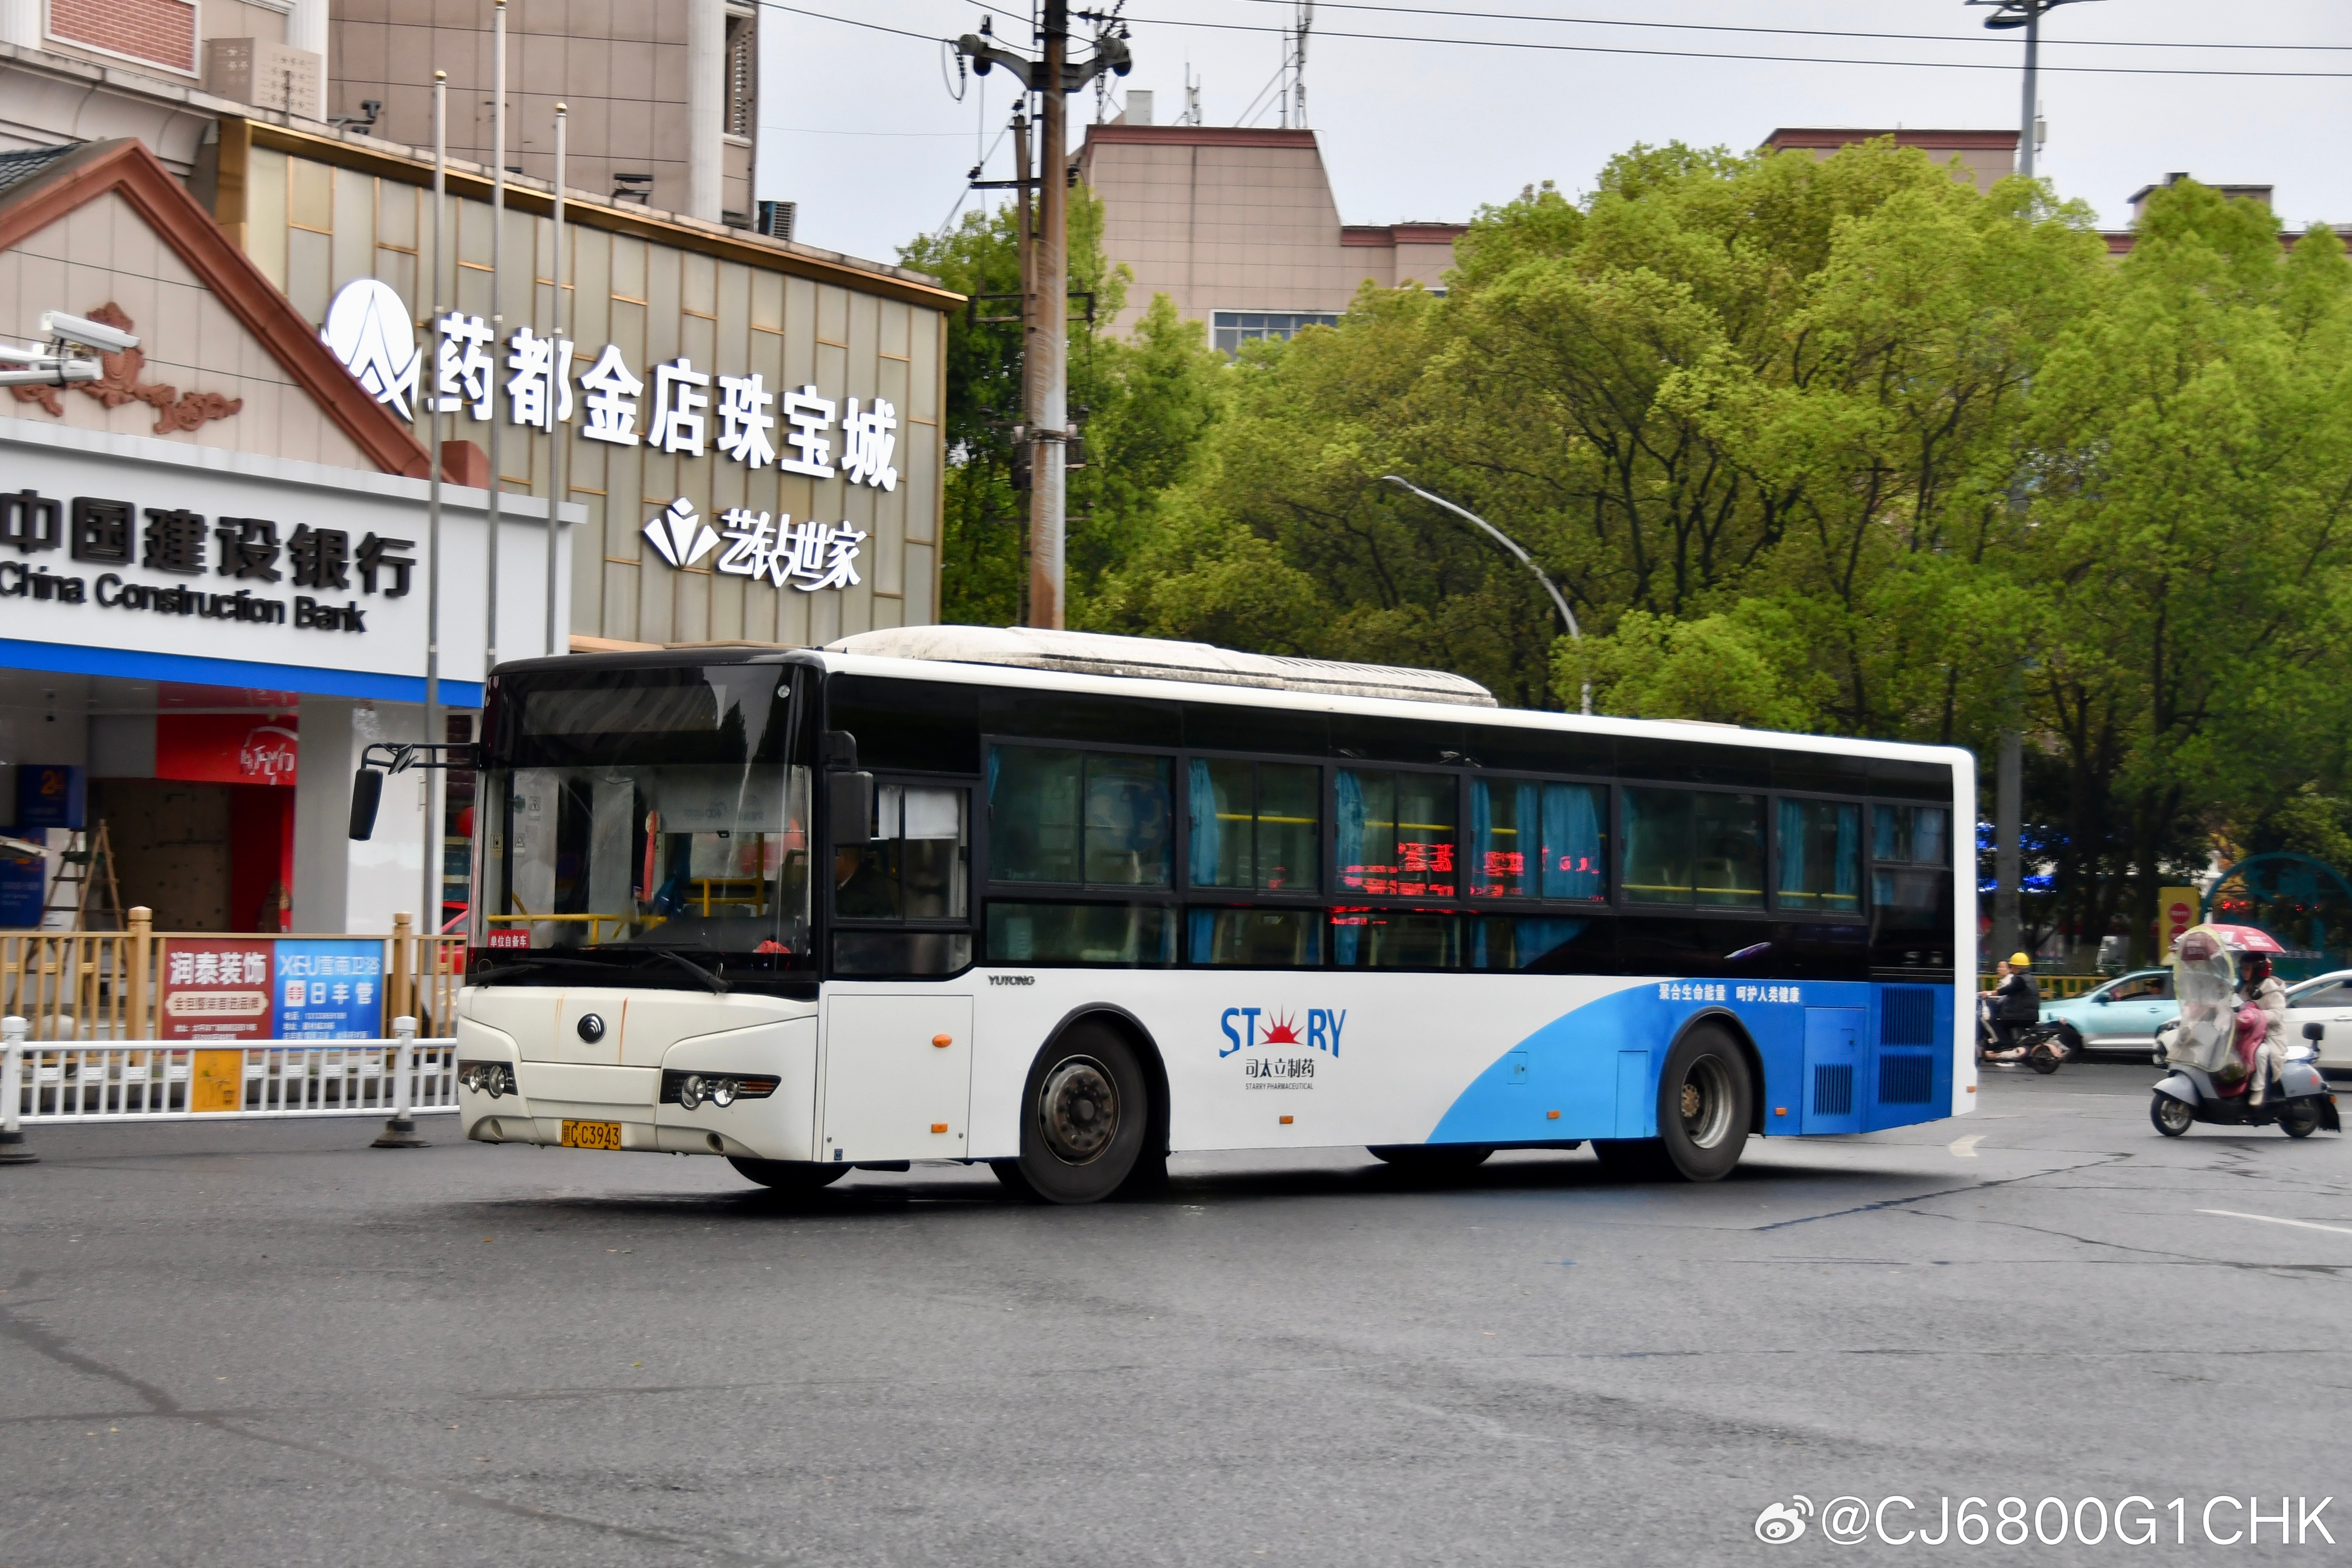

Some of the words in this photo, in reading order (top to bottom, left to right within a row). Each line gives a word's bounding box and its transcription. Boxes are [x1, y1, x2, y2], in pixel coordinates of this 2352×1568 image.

[428, 311, 898, 491] 药都金店珠宝城
[0, 489, 417, 597] 中国建设银行
[717, 507, 867, 592] 艺钻世家
[0, 560, 87, 603] China
[96, 573, 285, 624] Construction
[295, 596, 368, 633] Bank
[491, 935, 527, 947] 单位自备车
[170, 951, 267, 985] 润泰装饰
[987, 975, 1036, 985] YUTONG
[1659, 983, 1725, 1001] 聚合生命能量
[1736, 986, 1800, 1003] 呵护人类健康
[1245, 1058, 1315, 1078] 司太立制药
